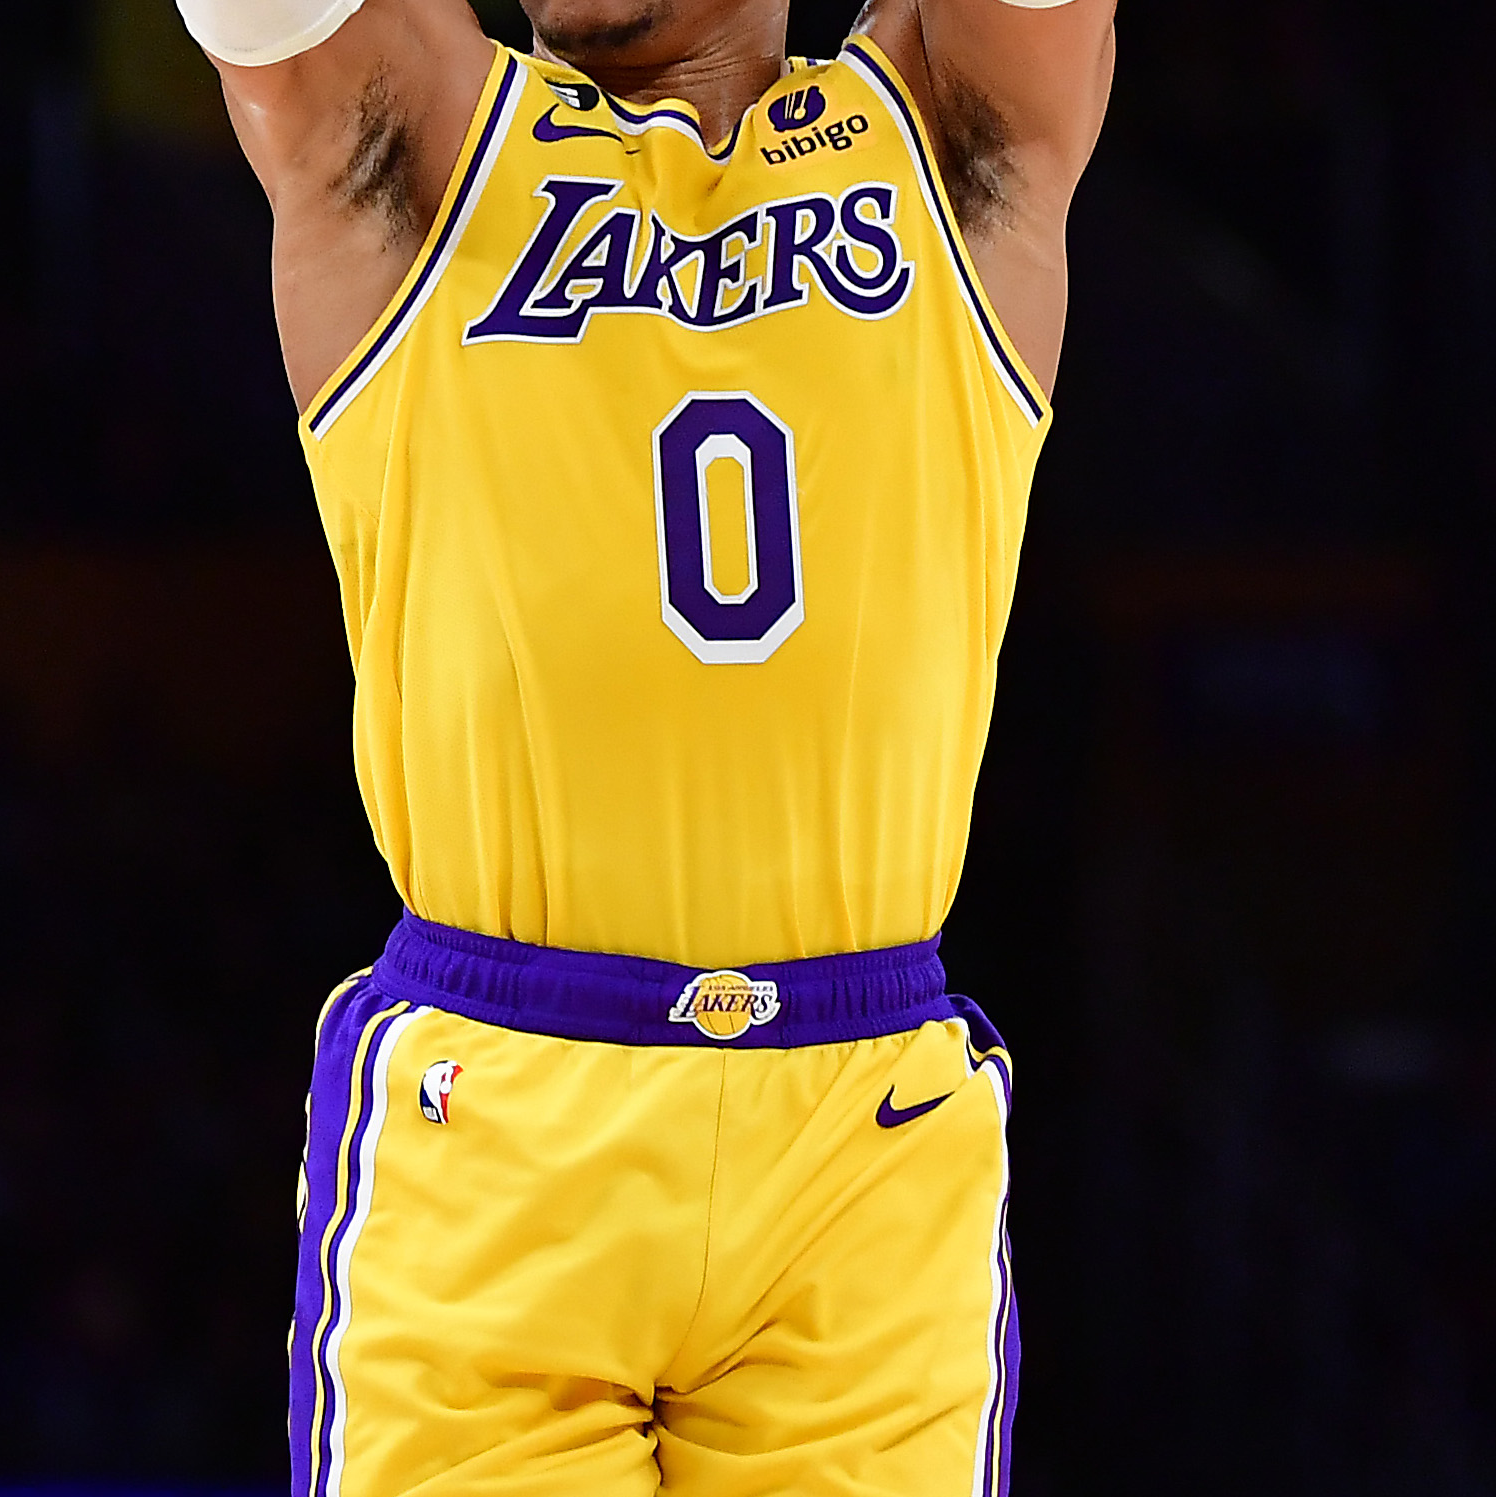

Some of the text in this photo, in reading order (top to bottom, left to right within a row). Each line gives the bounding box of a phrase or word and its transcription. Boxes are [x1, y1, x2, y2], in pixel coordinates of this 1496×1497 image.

[760, 115, 869, 165] bibigo
[462, 175, 916, 346] LAKERS
[652, 390, 805, 664] 0
[670, 986, 778, 1022] LAKERS
